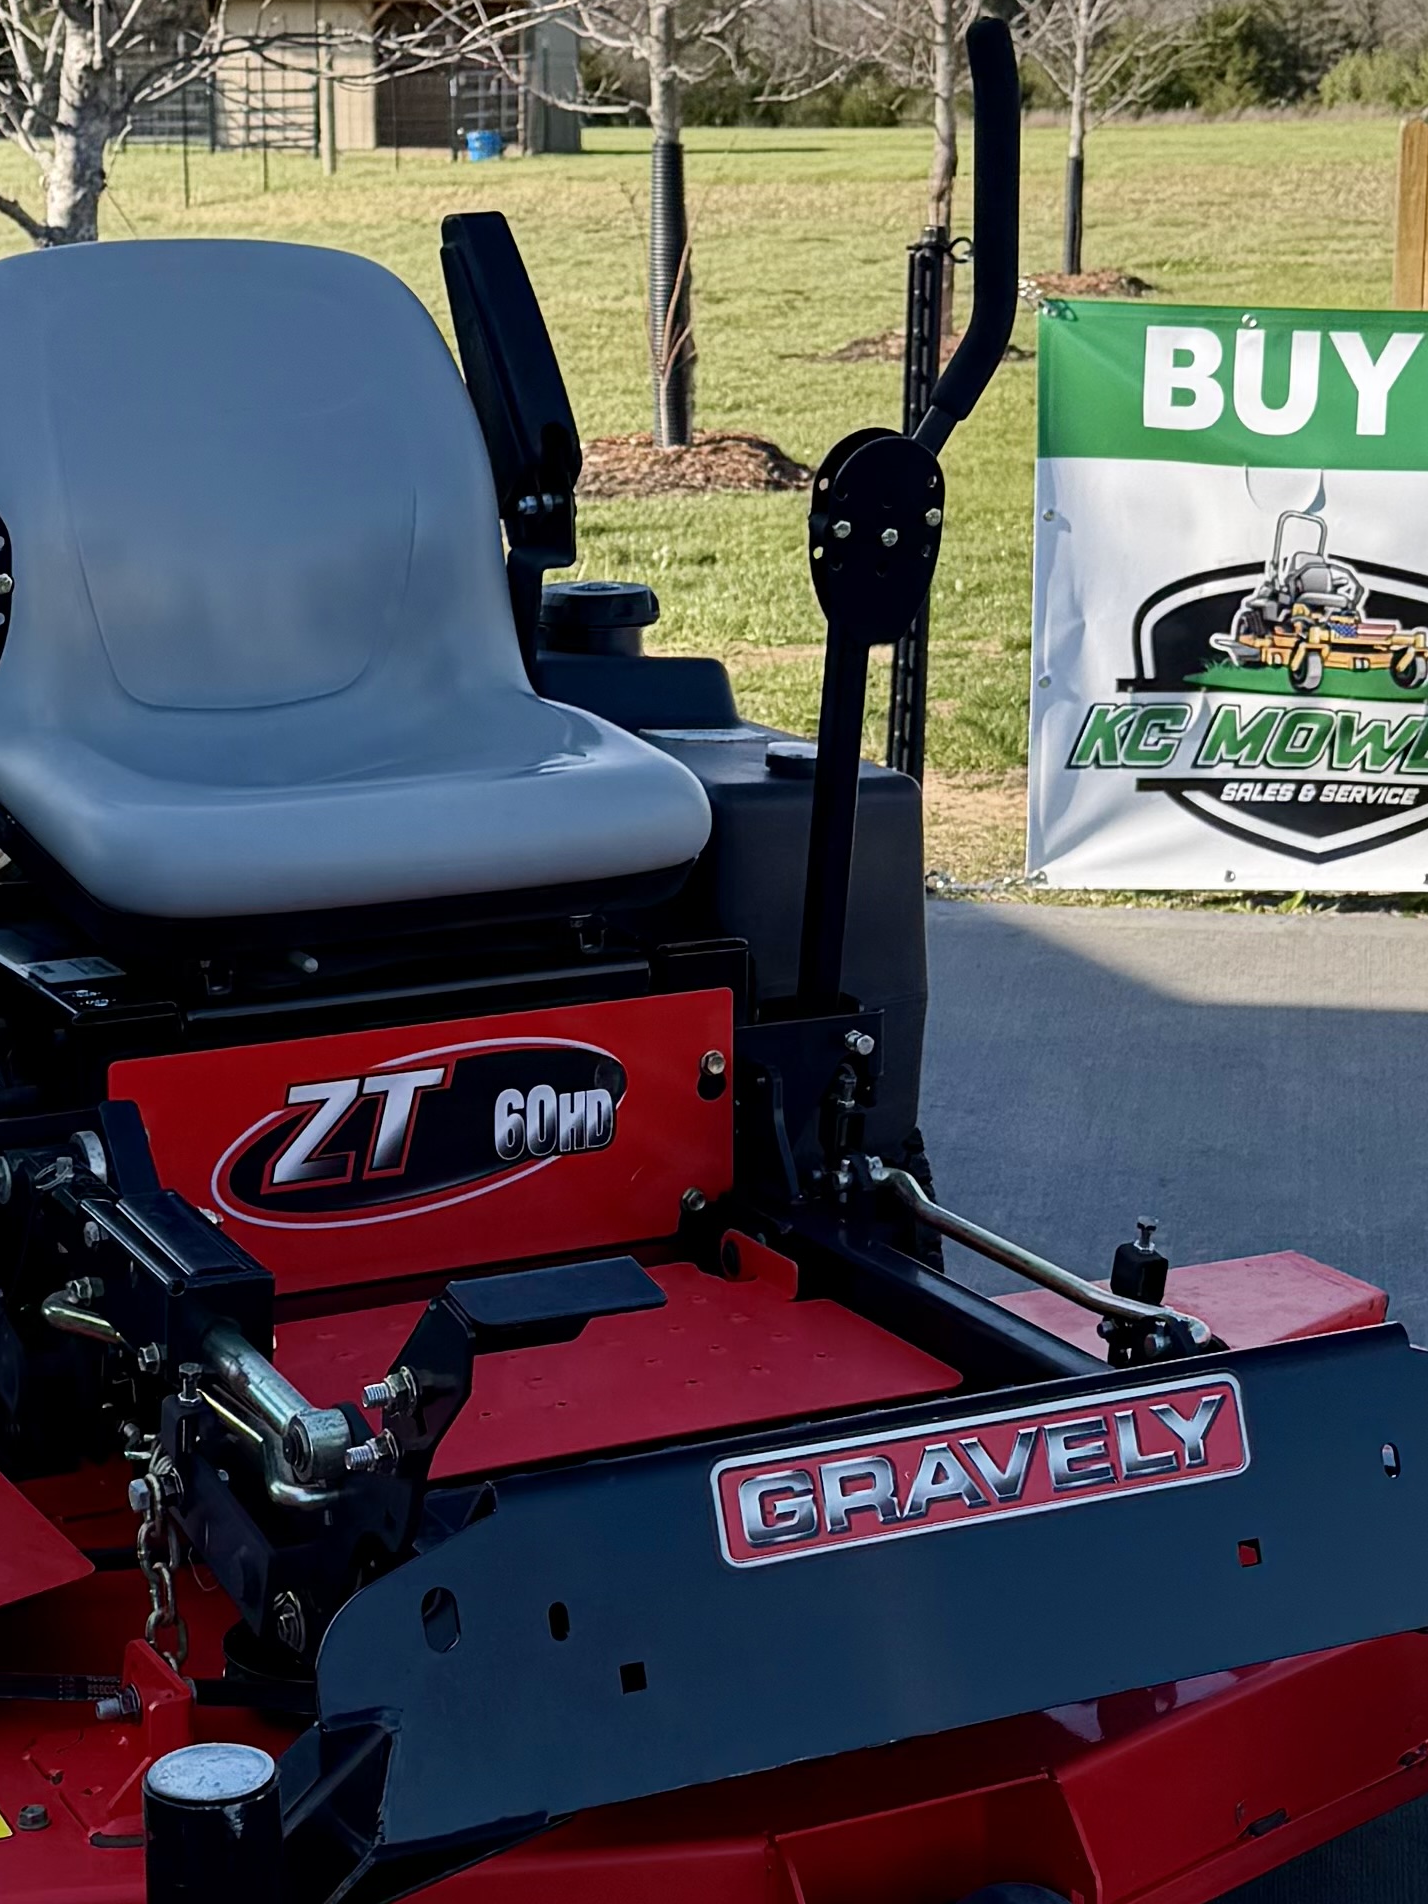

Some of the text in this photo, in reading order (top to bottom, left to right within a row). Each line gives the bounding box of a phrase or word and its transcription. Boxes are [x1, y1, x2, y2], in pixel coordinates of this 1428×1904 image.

[1143, 325, 1425, 436] BUY
[1067, 703, 1190, 769] KC
[1220, 782, 1420, 805] SALES & SERVICE
[267, 1063, 615, 1189] ZT 60HD
[737, 1393, 1224, 1546] GRAVELY
